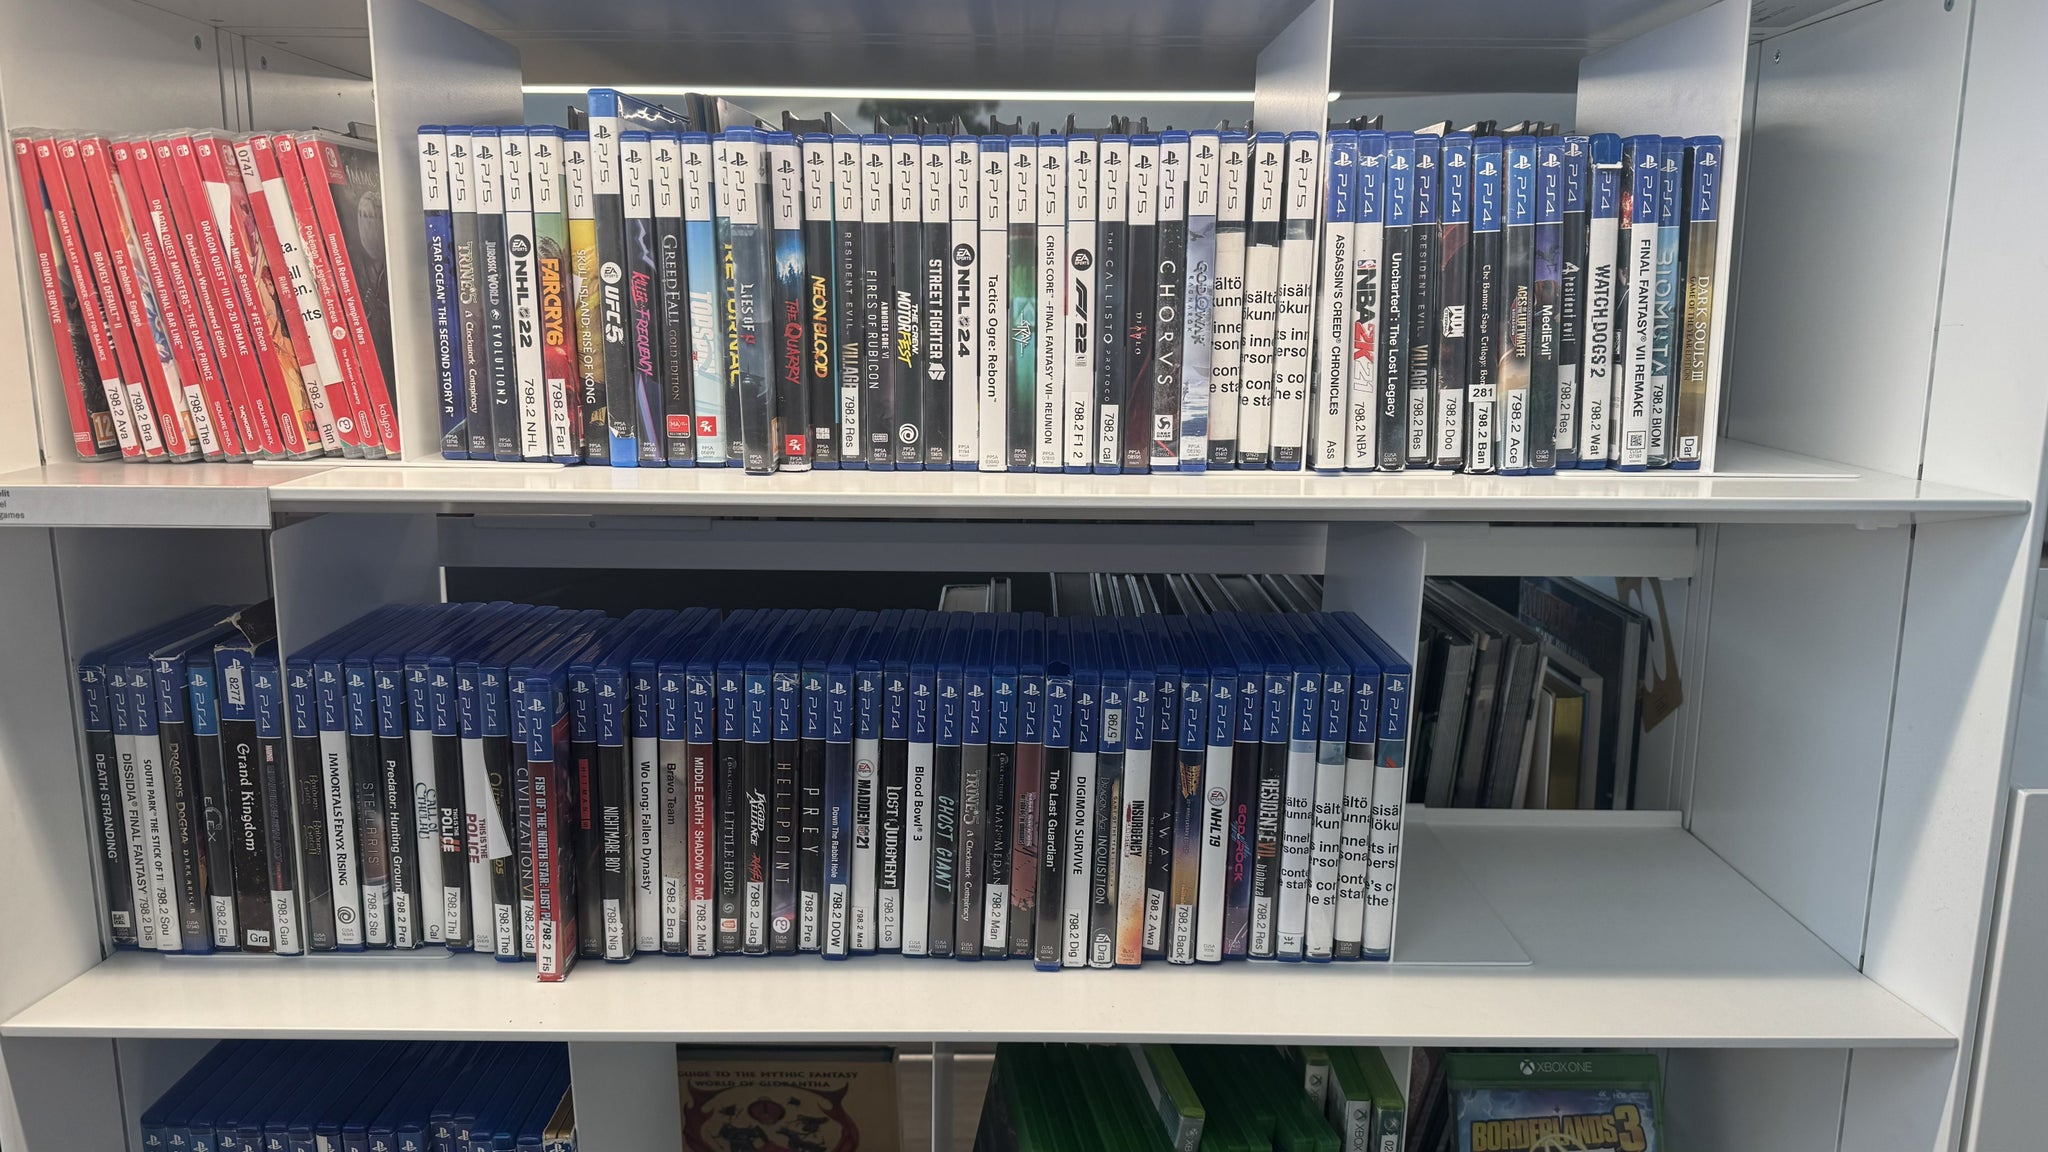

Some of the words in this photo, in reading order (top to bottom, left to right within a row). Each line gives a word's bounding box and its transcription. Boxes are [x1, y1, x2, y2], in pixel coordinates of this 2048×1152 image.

[237, 149, 254, 178] 0747
[69, 248, 79, 263] LAST
[432, 236, 444, 261] STAR
[1045, 235, 1056, 265] CRISIS
[1639, 239, 1651, 276] FINAL
[93, 251, 109, 285] BRAVELY
[844, 232, 852, 295] RESIDENT
[1332, 234, 1346, 298] ASSASSIN'S
[39, 253, 53, 287] DIGIMON
[46, 290, 61, 323] SURVIVE
[115, 250, 125, 266] Fire
[127, 301, 142, 327] Engage
[200, 221, 216, 251] DRAGON
[232, 327, 248, 356] REMAKE
[328, 234, 343, 264] Immortal
[343, 298, 361, 326] Vampire
[354, 327, 367, 345] Wars
[514, 260, 529, 306] NHL
[866, 270, 878, 310] FIRES
[929, 259, 942, 307] STREET
[957, 269, 970, 314] NHL
[987, 275, 999, 313] Tactics
[1697, 275, 1710, 317] DARK
[153, 288, 166, 307] FINAL
[325, 299, 340, 323] Arceus
[159, 309, 170, 324] BAR
[437, 306, 448, 326] THE
[212, 330, 228, 358] Edition
[253, 327, 268, 351] Encore
[582, 331, 593, 353] RISE
[929, 309, 943, 359] FIGHTER
[958, 329, 971, 357] 24
[985, 316, 998, 351] Ogre:
[1389, 326, 1401, 346] The
[1694, 322, 1707, 369] SOULS
[438, 329, 450, 367] SECOND
[584, 356, 594, 368] OF
[868, 332, 879, 389] RUBICON
[1388, 349, 1400, 374] Lost
[1634, 346, 1646, 362] VII
[441, 370, 452, 403] STORY
[584, 370, 596, 404] KONG
[1329, 346, 1341, 415] CHRONICLES
[1632, 365, 1645, 417] REMAKE
[130, 391, 148, 421] 798.2
[524, 379, 536, 417] 798.2
[551, 383, 563, 422] 798.2
[1385, 378, 1398, 417] Legacy
[1560, 380, 1571, 410] 798.2
[1652, 384, 1664, 414] 798.2
[189, 393, 203, 424] 798.2
[198, 426, 212, 445] The
[1044, 402, 1054, 444] REUNION
[1073, 400, 1085, 430] 798.2
[1413, 397, 1424, 426] 798.2
[1445, 397, 1456, 426] 798.2
[1510, 393, 1522, 435] 798.2
[1559, 413, 1570, 433] Res
[138, 423, 152, 442] Bra
[527, 422, 538, 452] NHL
[554, 427, 566, 450] Far
[1103, 413, 1115, 442] 798.2
[1412, 429, 1423, 450] Res
[1444, 429, 1456, 450] Doo
[1651, 418, 1662, 447] BIOM
[1102, 447, 1114, 463] cal
[1326, 440, 1337, 459] Ass
[1509, 438, 1521, 463] Ace
[1683, 437, 1695, 457] Dar
[229, 677, 241, 701] 8277
[95, 753, 109, 791] DEATH
[143, 759, 154, 786] SOUTH
[640, 761, 651, 776] Wo
[666, 763, 676, 795] Bravo
[694, 757, 704, 792] MIDDLE
[914, 766, 924, 798] Blood
[1049, 770, 1060, 790] The
[328, 753, 341, 817] IMMORTALS
[386, 760, 399, 808] Predator:
[534, 776, 546, 796] FIST
[639, 779, 651, 811] Long:
[535, 797, 546, 809] OF
[667, 797, 677, 825] Team
[856, 779, 871, 824] MADDEN
[1048, 792, 1059, 815] Last
[1073, 776, 1086, 827] DIGIMON
[128, 810, 141, 842] FINAL
[149, 818, 159, 835] THE
[389, 812, 402, 853] Hunting
[536, 811, 547, 828] THE
[603, 806, 619, 854] NIGHTMARE
[641, 814, 652, 846] Fallen
[938, 796, 955, 841] GHOST
[1129, 800, 1145, 857] INSURGENCY
[1210, 807, 1223, 833] NHL
[151, 837, 161, 860] STICK
[536, 830, 548, 859] NORTH
[694, 831, 705, 870] SHADOW
[1072, 829, 1085, 875] SURVIVE
[605, 857, 620, 874] BOY
[694, 873, 705, 884] OF
[935, 848, 953, 892] GIANT
[139, 897, 150, 923] 798.2
[215, 900, 227, 926] 798.2
[277, 898, 289, 923] 798.2
[395, 895, 406, 923] 798.2
[446, 891, 458, 918] 798.2
[539, 888, 550, 912] LOST
[749, 884, 760, 919] 798.2
[832, 891, 843, 918] 798.2
[991, 891, 1003, 918] 798.2
[448, 920, 459, 934] Thi
[524, 905, 535, 931] 798.2
[607, 906, 617, 933] 798.2
[696, 903, 706, 930] 798.2
[1068, 913, 1080, 939] 798.2
[1178, 906, 1189, 933] 798.2
[1256, 902, 1268, 929] 798.2
[143, 926, 154, 941] Dis
[217, 928, 228, 943] Ele
[280, 926, 291, 946] Gua
[397, 925, 408, 943] Pre
[429, 924, 440, 939] Cal
[525, 934, 535, 949] Sid
[606, 935, 619, 950] Nig
[696, 934, 707, 952] Mid
[747, 922, 760, 944] Jag
[831, 921, 842, 947] DOW
[856, 932, 864, 948] Mad
[990, 920, 1001, 940] Man
[1255, 931, 1266, 949] Res
[1068, 941, 1080, 958] Dig
[1176, 935, 1188, 959] Back
[540, 956, 552, 972] Fis
[1613, 1104, 1647, 1152] 3
